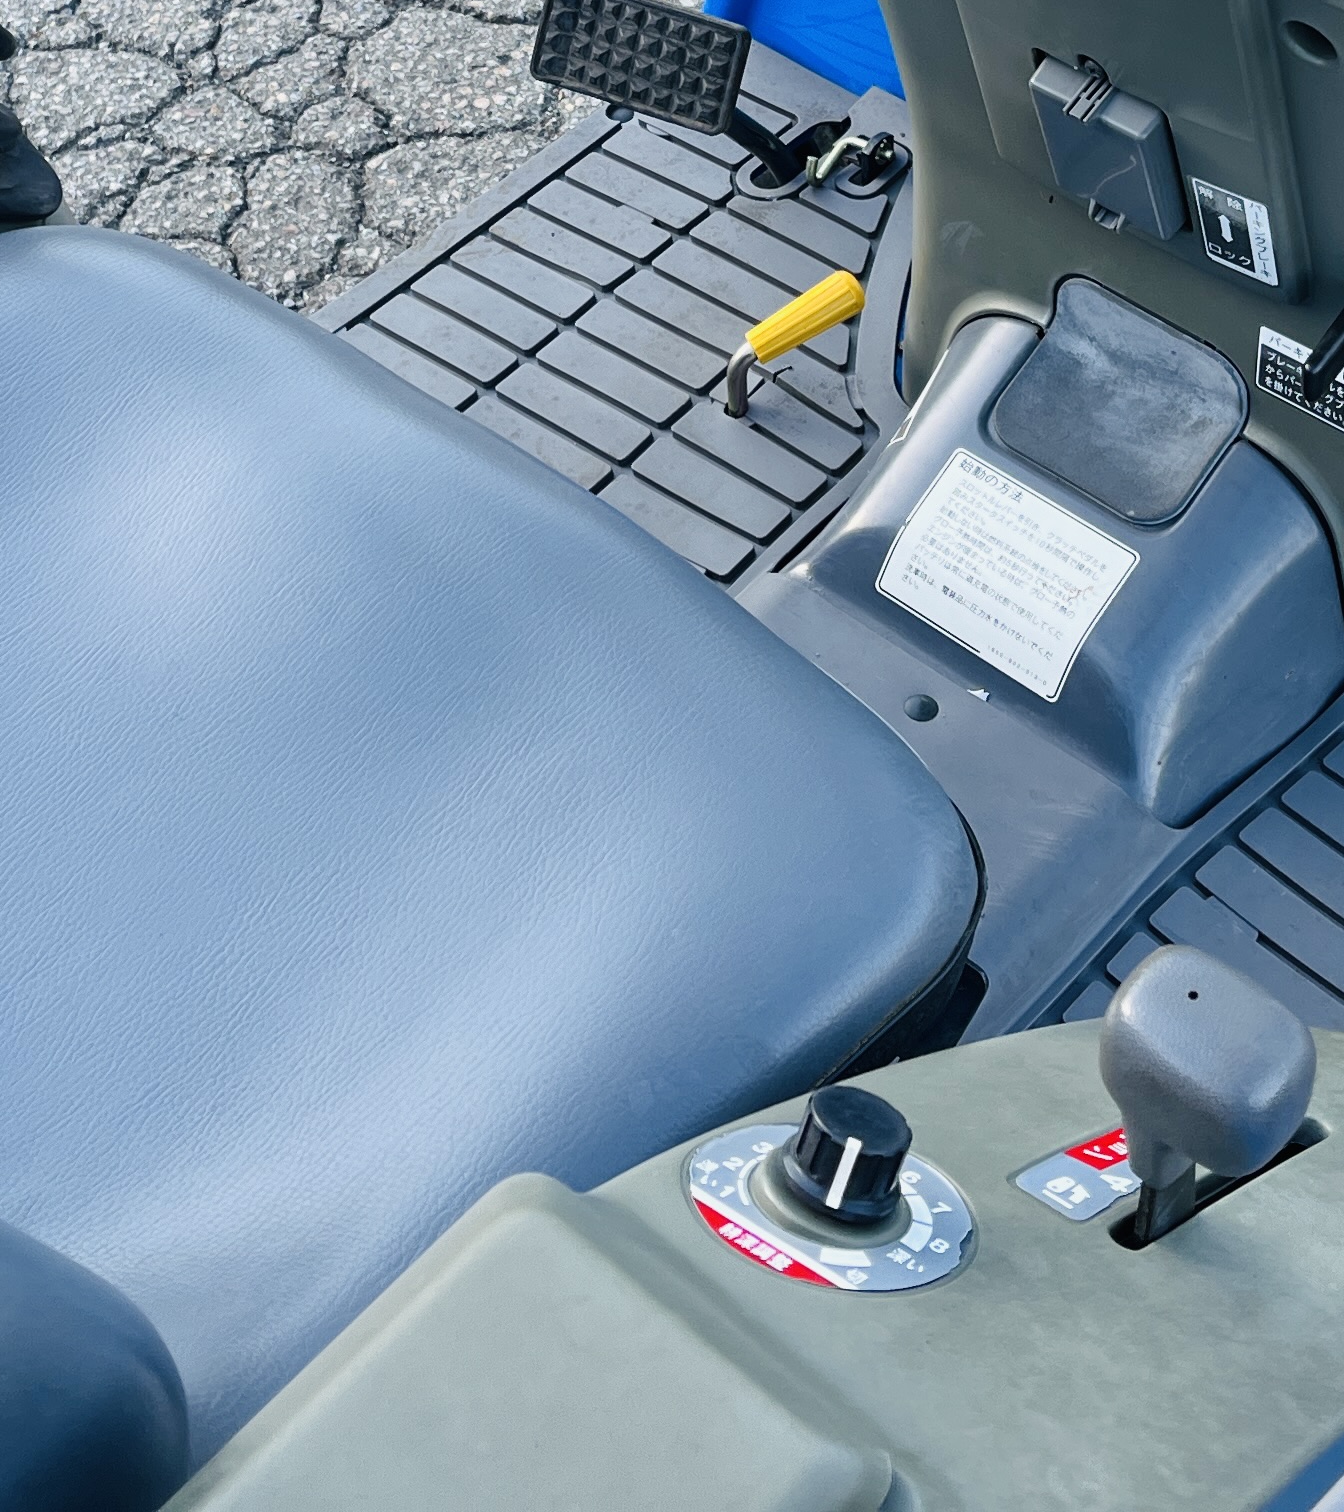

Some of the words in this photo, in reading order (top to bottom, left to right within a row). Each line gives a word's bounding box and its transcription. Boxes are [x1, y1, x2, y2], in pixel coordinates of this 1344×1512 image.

[1209, 242, 1252, 266] ロック
[752, 1141, 774, 1155] 3
[722, 1156, 744, 1171] 2
[901, 1170, 922, 1184] 6
[1099, 1174, 1134, 1194] 4
[719, 1185, 735, 1199] 1
[931, 1201, 953, 1214] 7
[929, 1237, 951, 1254] 8
